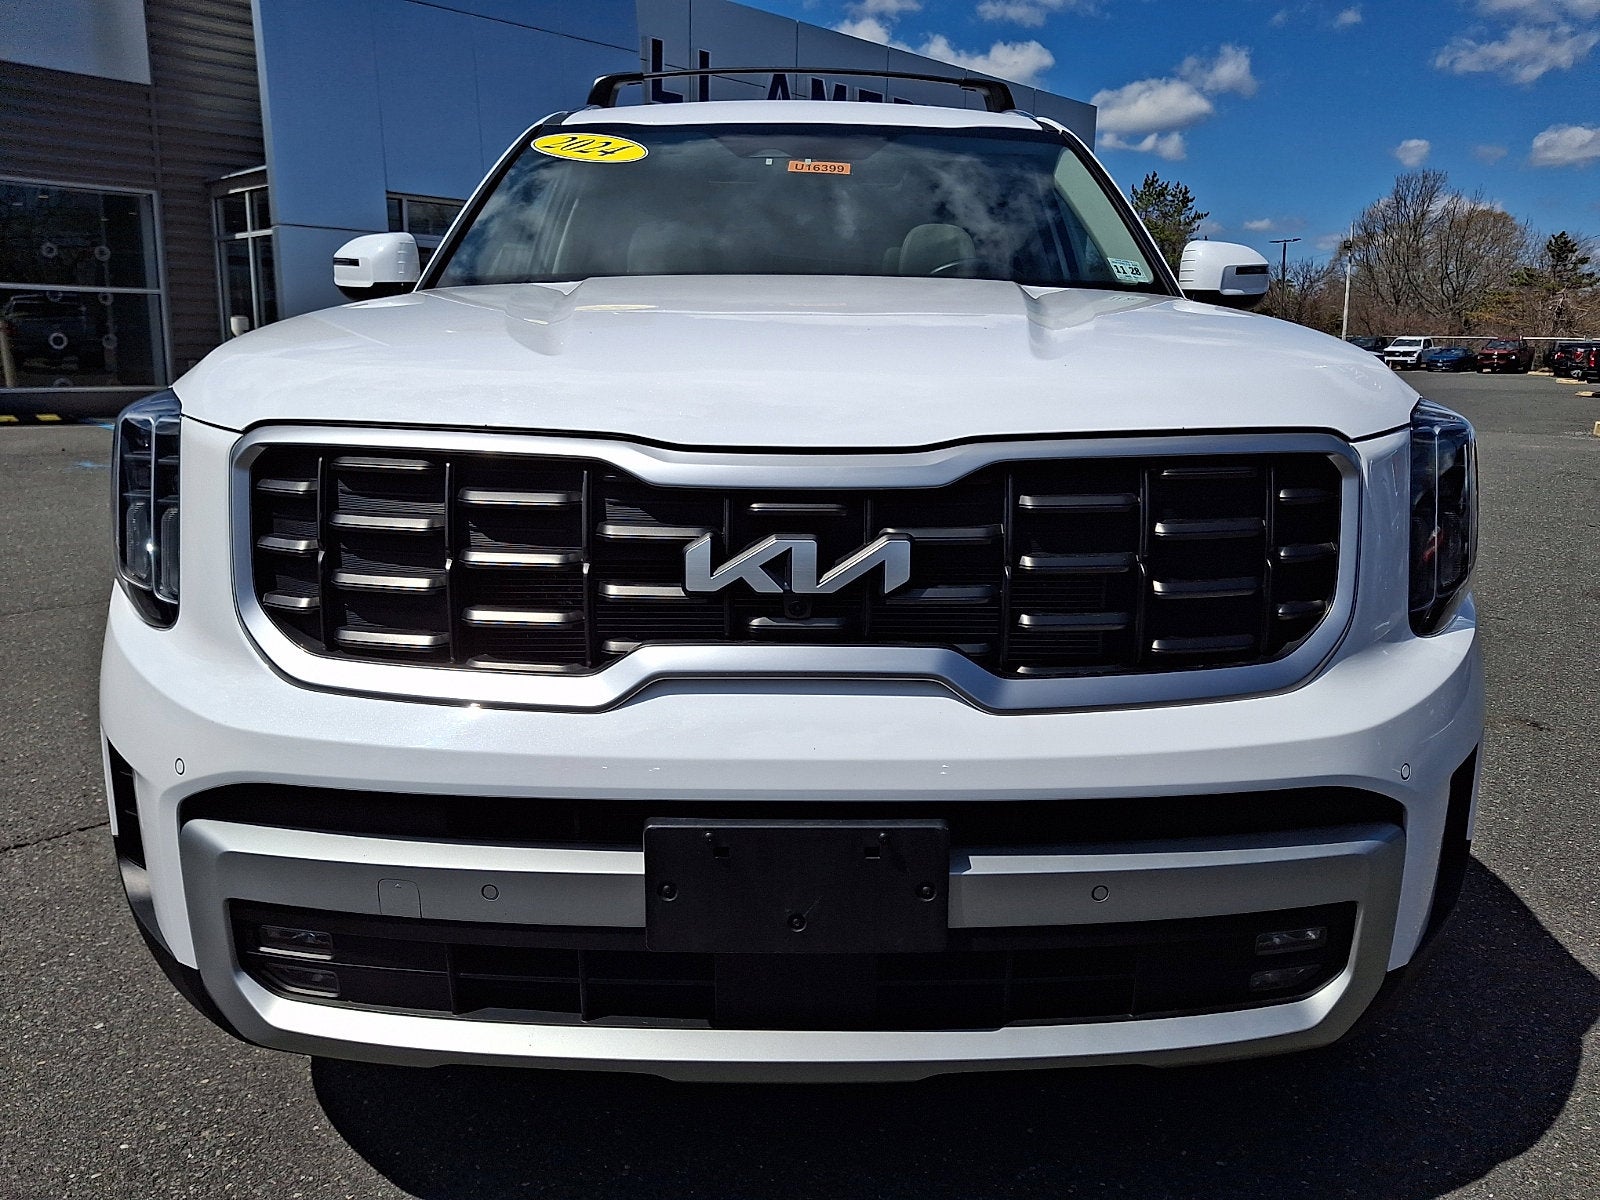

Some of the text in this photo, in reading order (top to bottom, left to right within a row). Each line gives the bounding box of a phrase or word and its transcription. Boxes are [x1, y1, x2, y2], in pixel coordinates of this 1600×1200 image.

[542, 136, 634, 157] 2024
[794, 163, 845, 173] U16399
[1113, 265, 1127, 274] 11
[685, 534, 911, 594] KIA
